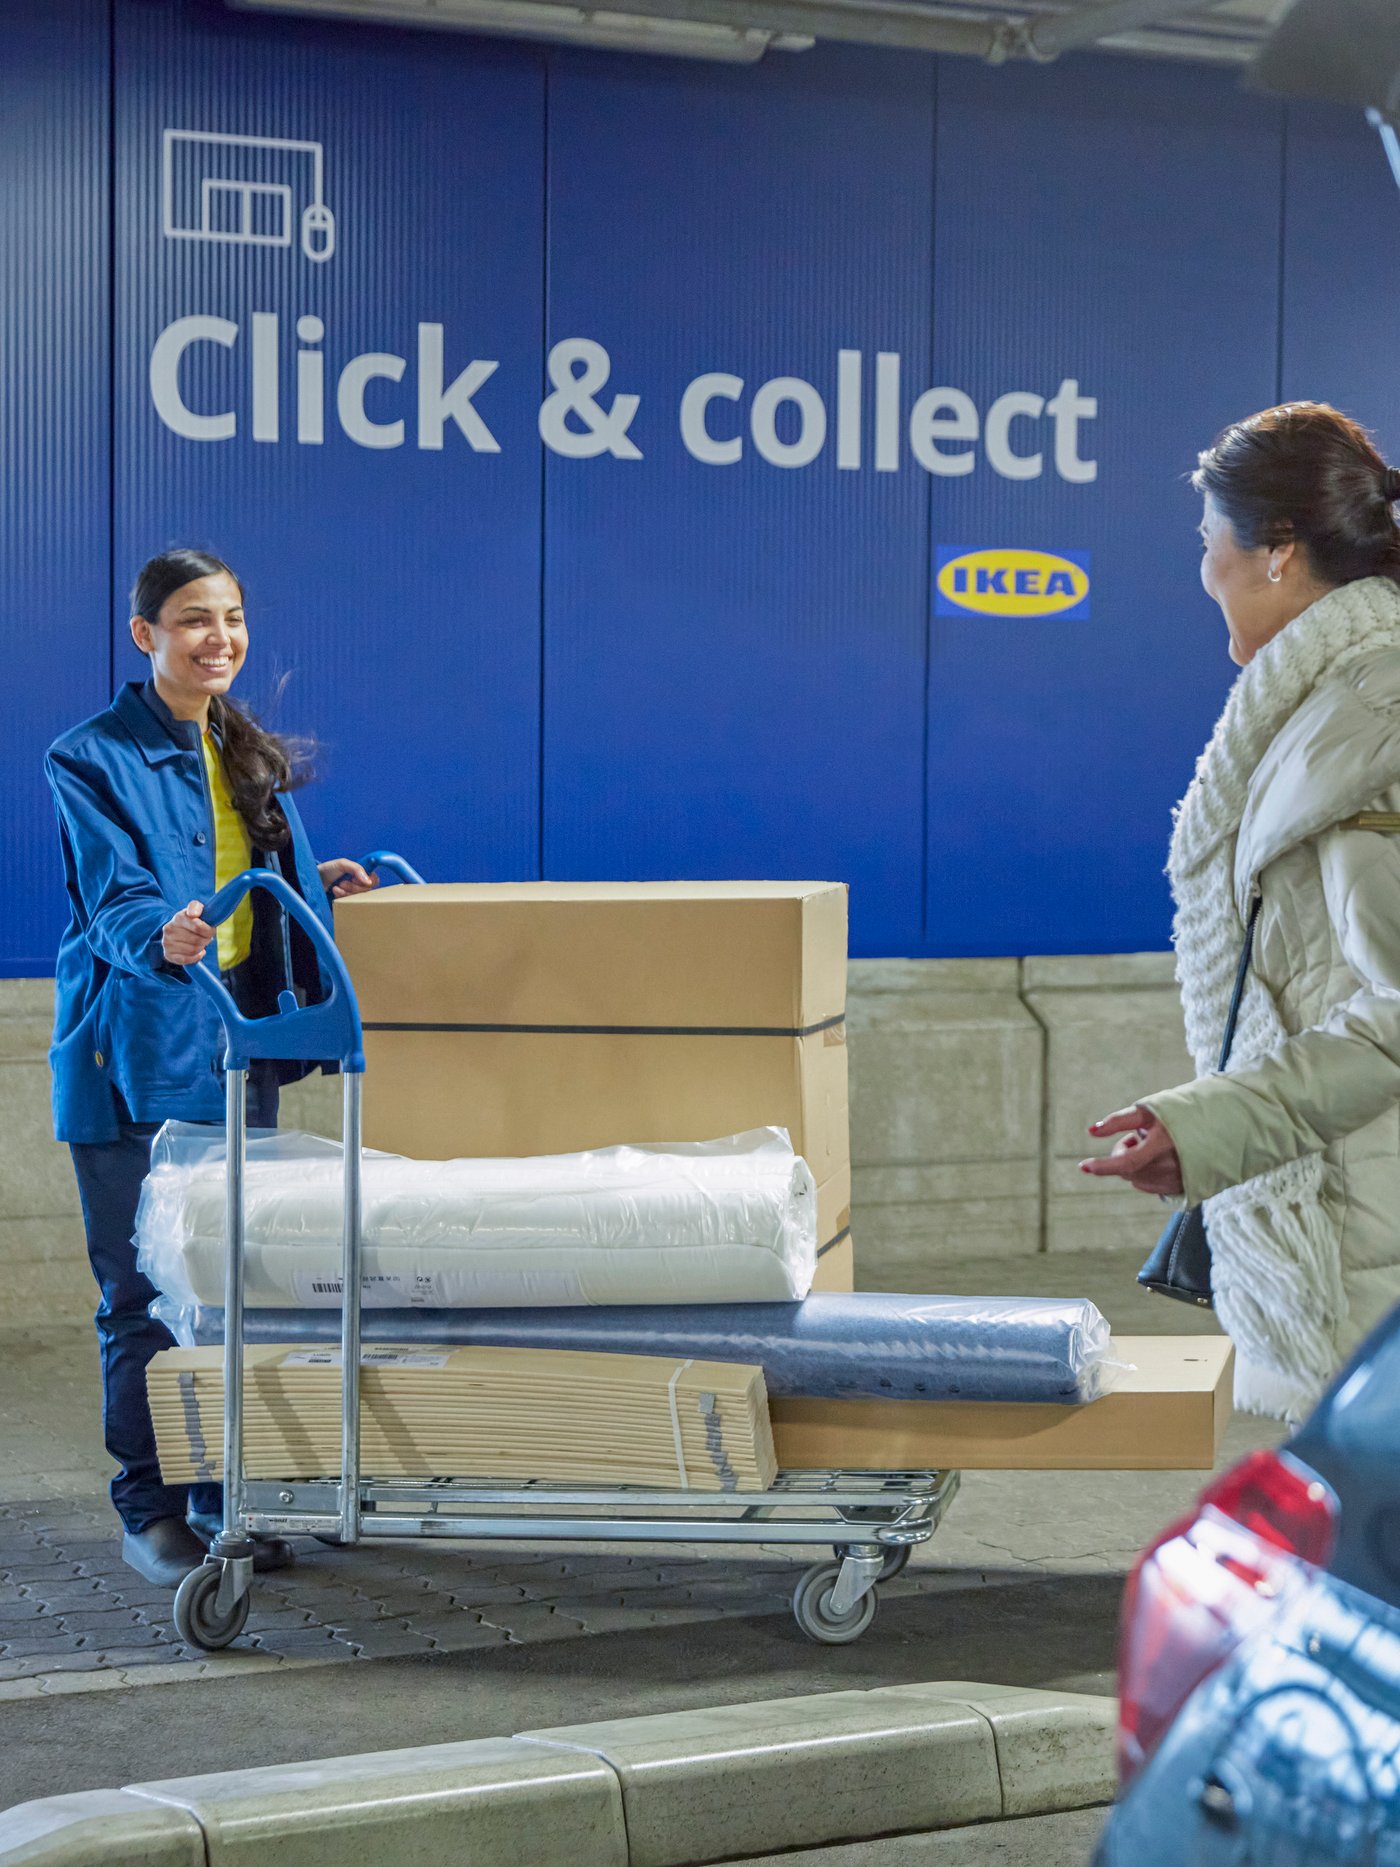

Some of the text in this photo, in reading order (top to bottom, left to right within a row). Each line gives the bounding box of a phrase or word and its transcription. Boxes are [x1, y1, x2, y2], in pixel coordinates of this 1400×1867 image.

[149, 311, 1098, 484] Click & collect
[953, 567, 1077, 596] IKEA
